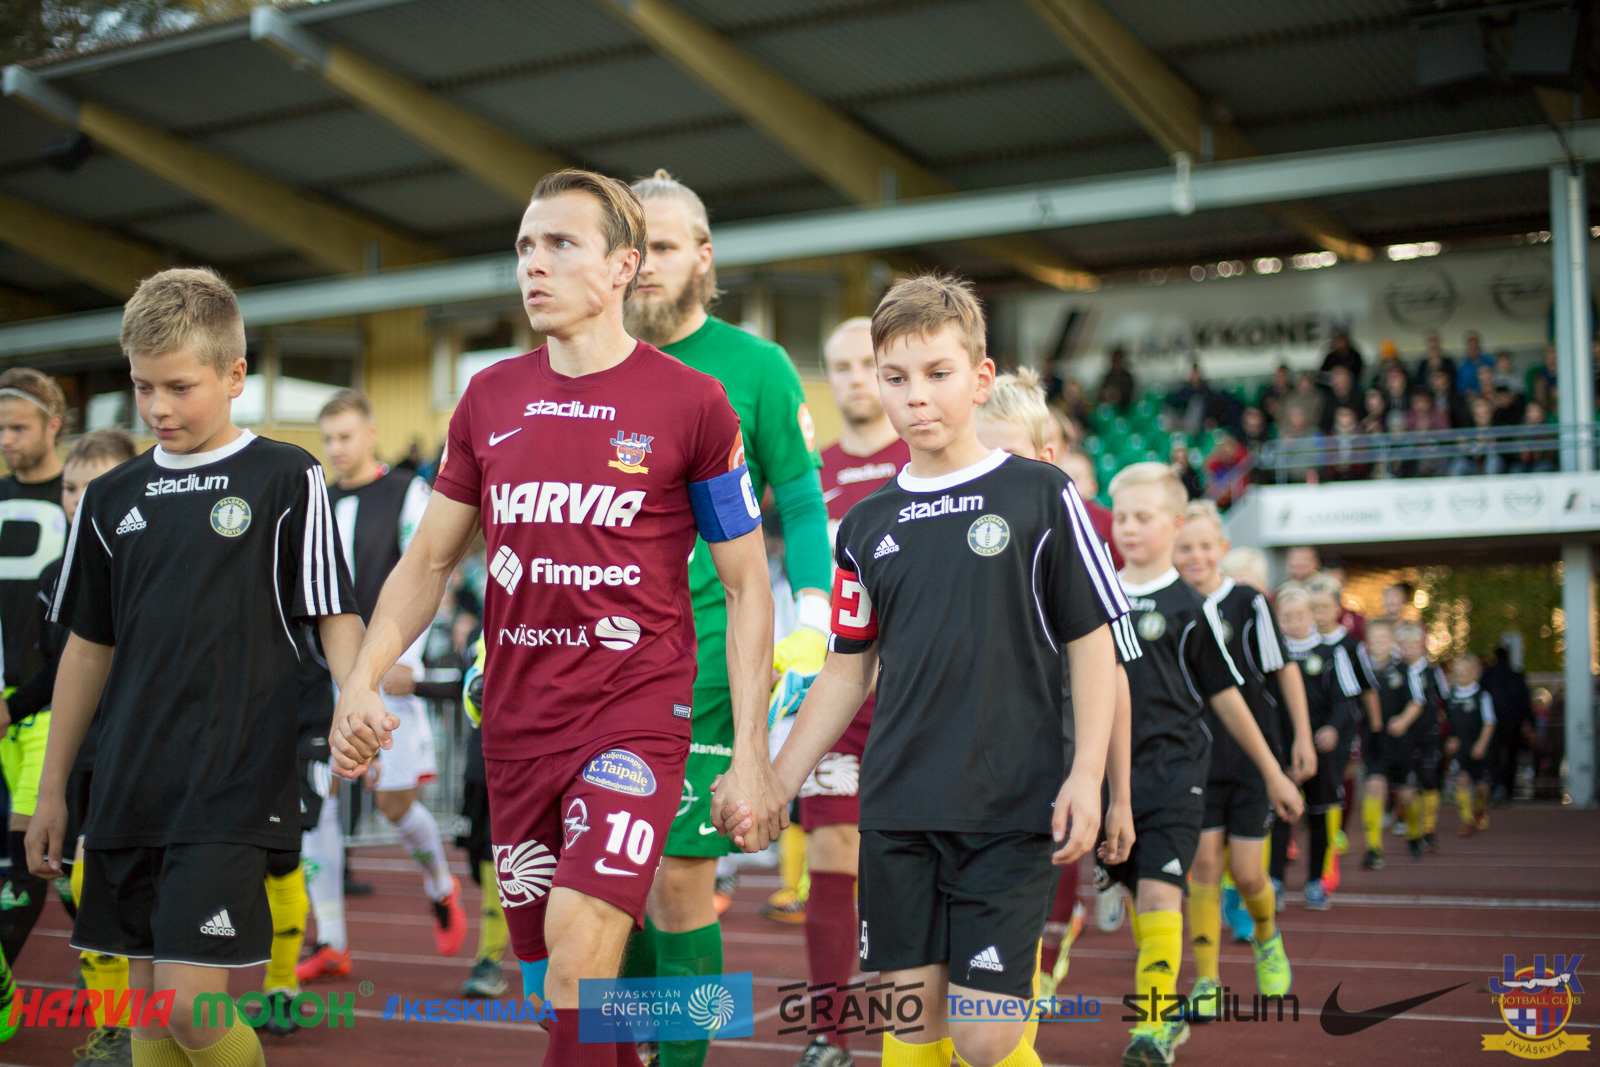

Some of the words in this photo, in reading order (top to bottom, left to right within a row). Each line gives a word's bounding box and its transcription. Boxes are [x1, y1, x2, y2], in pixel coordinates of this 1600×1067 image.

[524, 400, 616, 421] stadium
[610, 430, 655, 454] JJK
[145, 474, 229, 496] stadium
[490, 481, 646, 527] HARVIA
[898, 495, 984, 522] stadium
[116, 520, 147, 535] adidas
[874, 544, 899, 559] adidas
[498, 624, 590, 647] YVÄSKYLÄ
[601, 751, 643, 770] Kuljetusapu
[601, 760, 648, 787] Taipale
[606, 810, 655, 865] 10
[200, 925, 236, 937] adidas
[970, 959, 1003, 971] adidas
